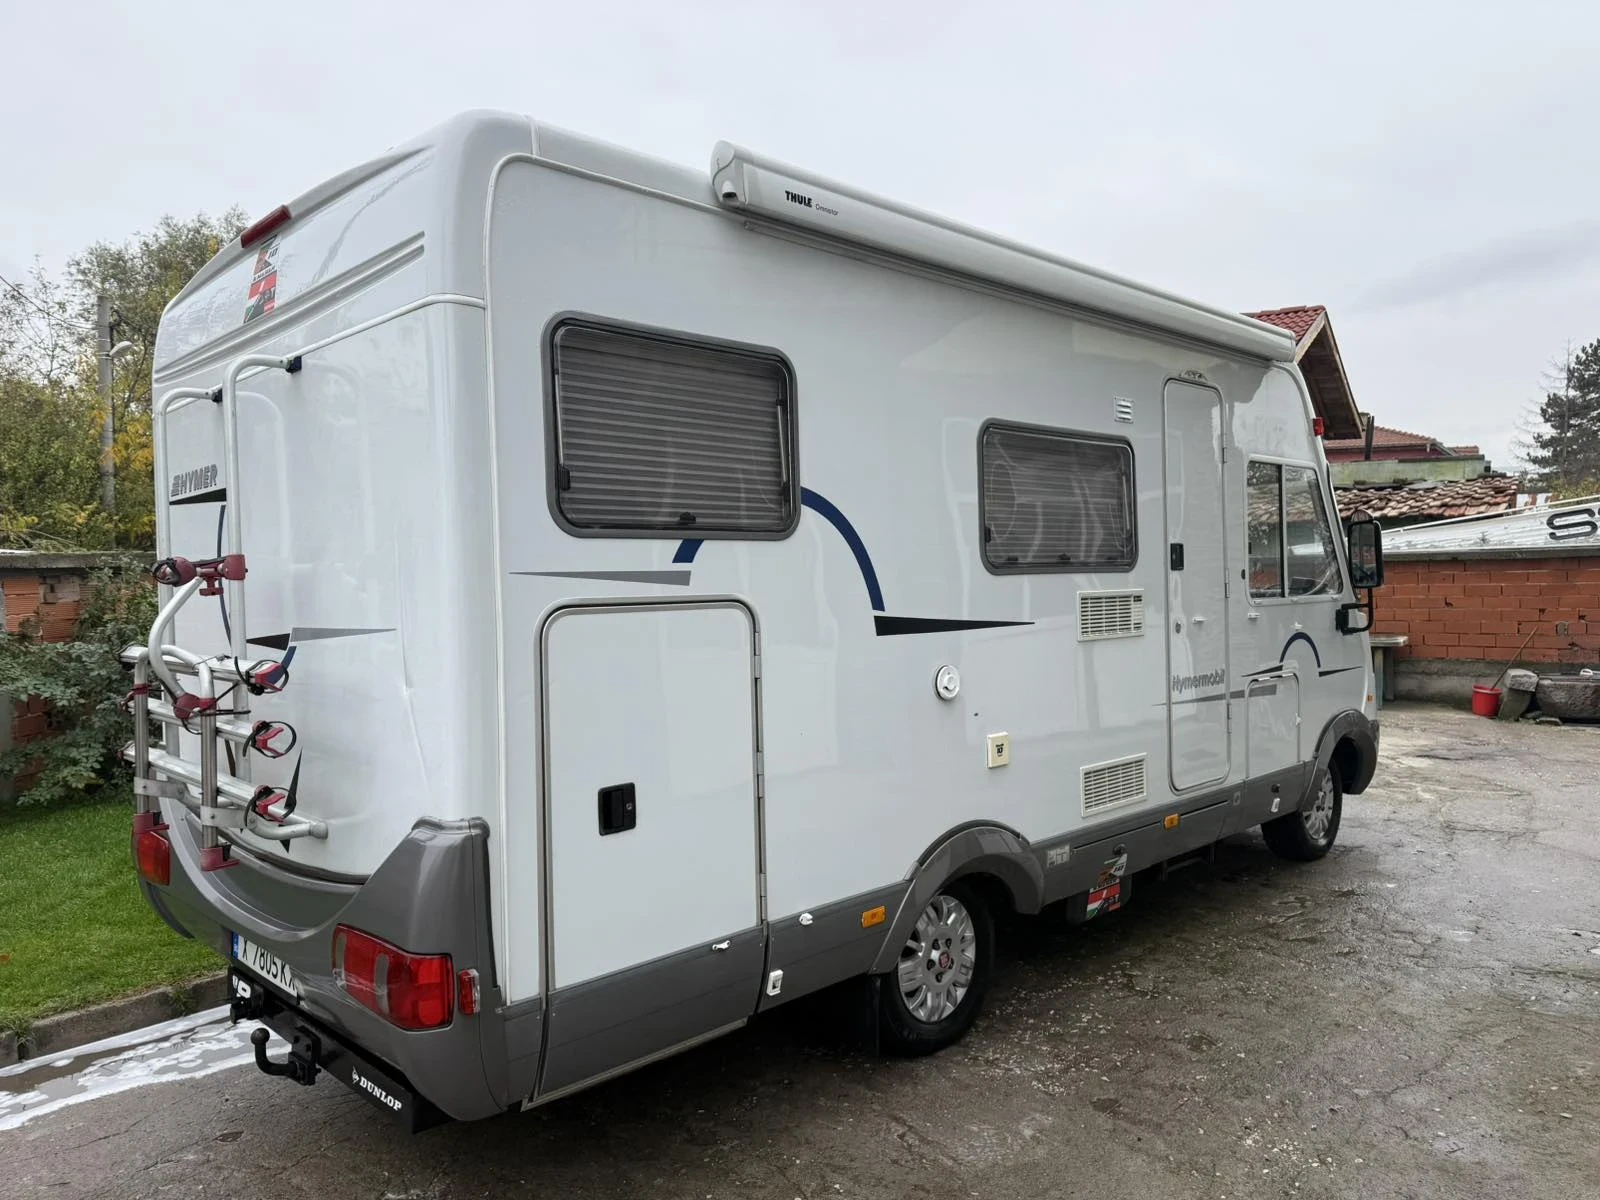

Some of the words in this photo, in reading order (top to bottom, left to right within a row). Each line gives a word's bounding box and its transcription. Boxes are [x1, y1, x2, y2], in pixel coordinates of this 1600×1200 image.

[785, 190, 813, 208] THULE
[181, 463, 218, 495] HYMER
[1546, 508, 1600, 541] S
[1172, 668, 1225, 694] Hymermobil
[360, 1075, 402, 1111] DUNLOP
